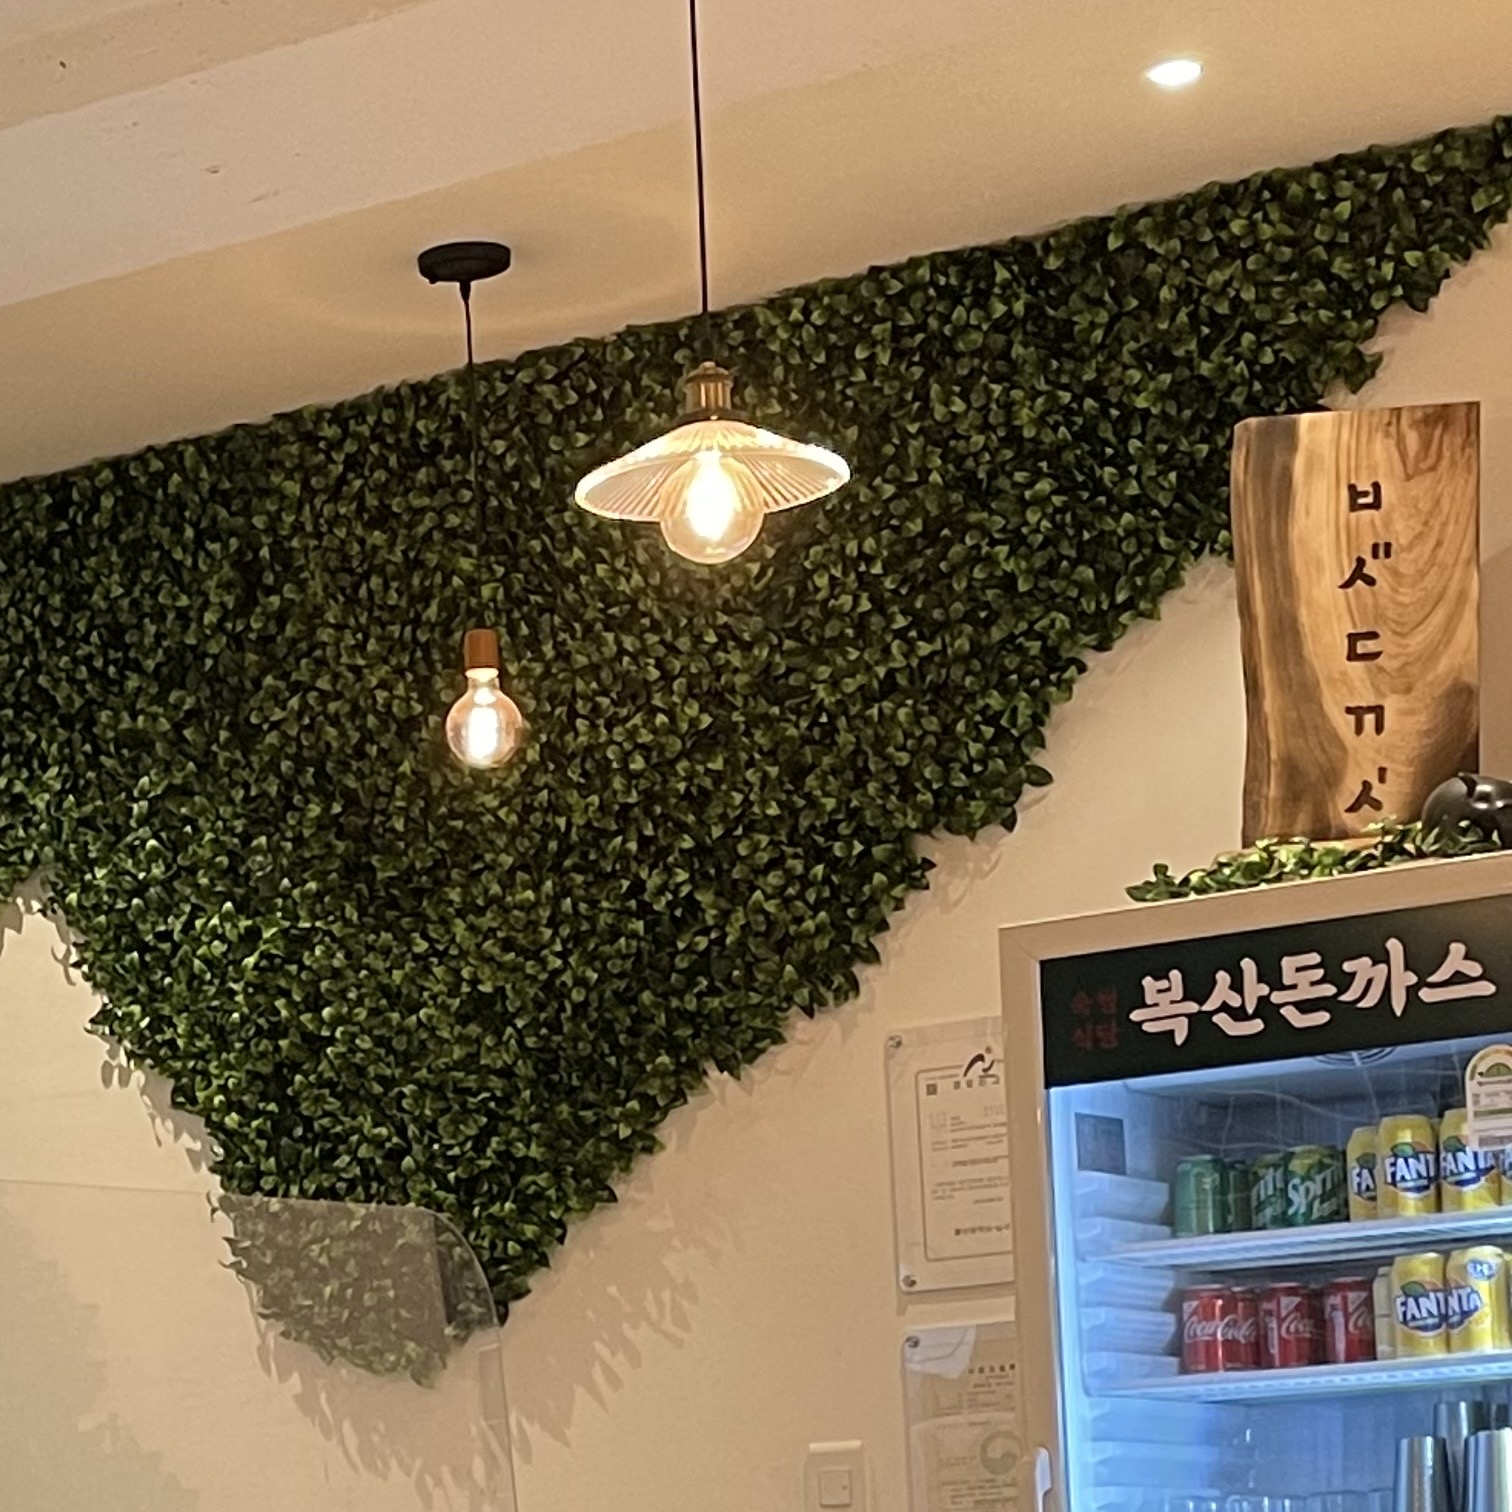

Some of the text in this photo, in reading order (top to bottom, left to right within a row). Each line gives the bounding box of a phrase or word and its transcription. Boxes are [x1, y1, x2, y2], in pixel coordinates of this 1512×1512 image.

[1128, 936, 1497, 1047] 복산돈까스
[1384, 1152, 1437, 1185] FANT
[1395, 1290, 1446, 1323] FANT
